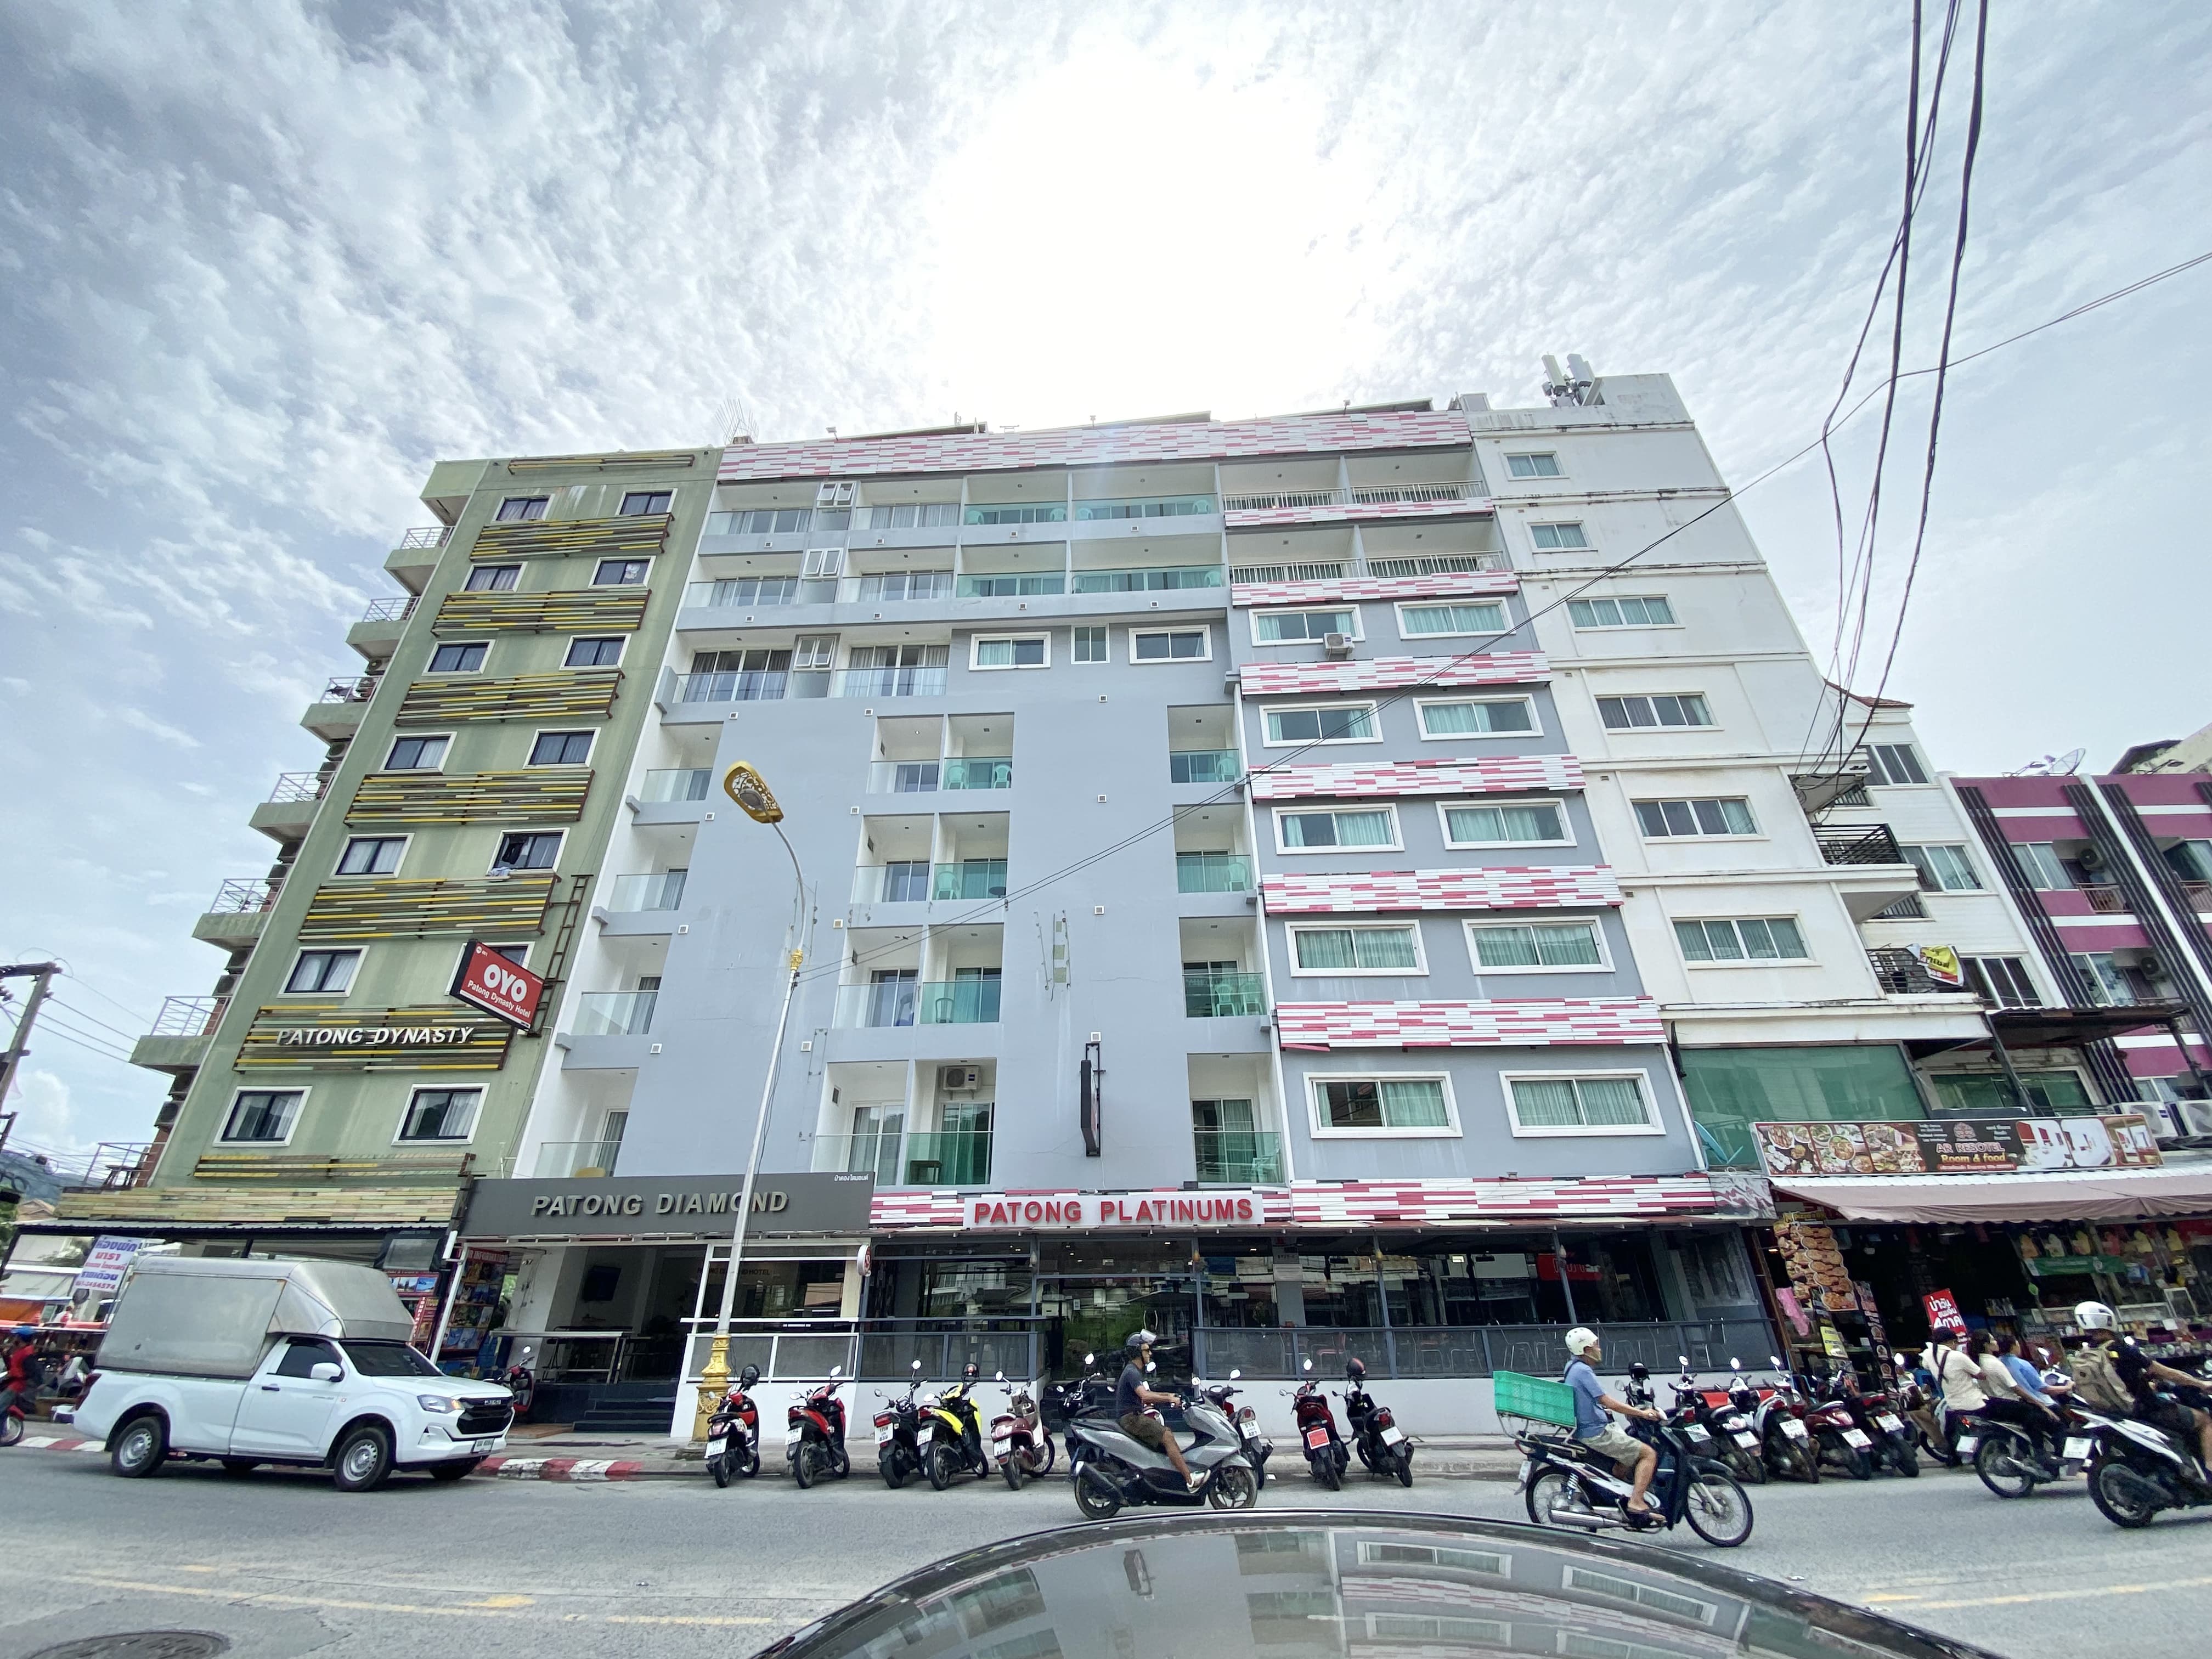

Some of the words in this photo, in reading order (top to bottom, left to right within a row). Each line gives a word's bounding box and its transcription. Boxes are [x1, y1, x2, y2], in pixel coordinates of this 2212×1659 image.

[484, 964, 527, 1002] OYO
[467, 980, 489, 998] Patong
[491, 992, 515, 1011] Dynasty
[515, 1005, 531, 1018] Hotel
[276, 1028, 364, 1045] PATONG
[373, 1026, 475, 1045] DYNASTY
[1936, 1143, 1954, 1153] AR
[1955, 1142, 2005, 1153] RESOTEL
[1940, 1154, 1970, 1163] Room
[1973, 1154, 1980, 1163] &
[1983, 1152, 2006, 1163] food
[531, 1195, 644, 1216] PATONG
[974, 1201, 1081, 1223] PATONG
[1101, 1198, 1253, 1222] PLATINUMS
